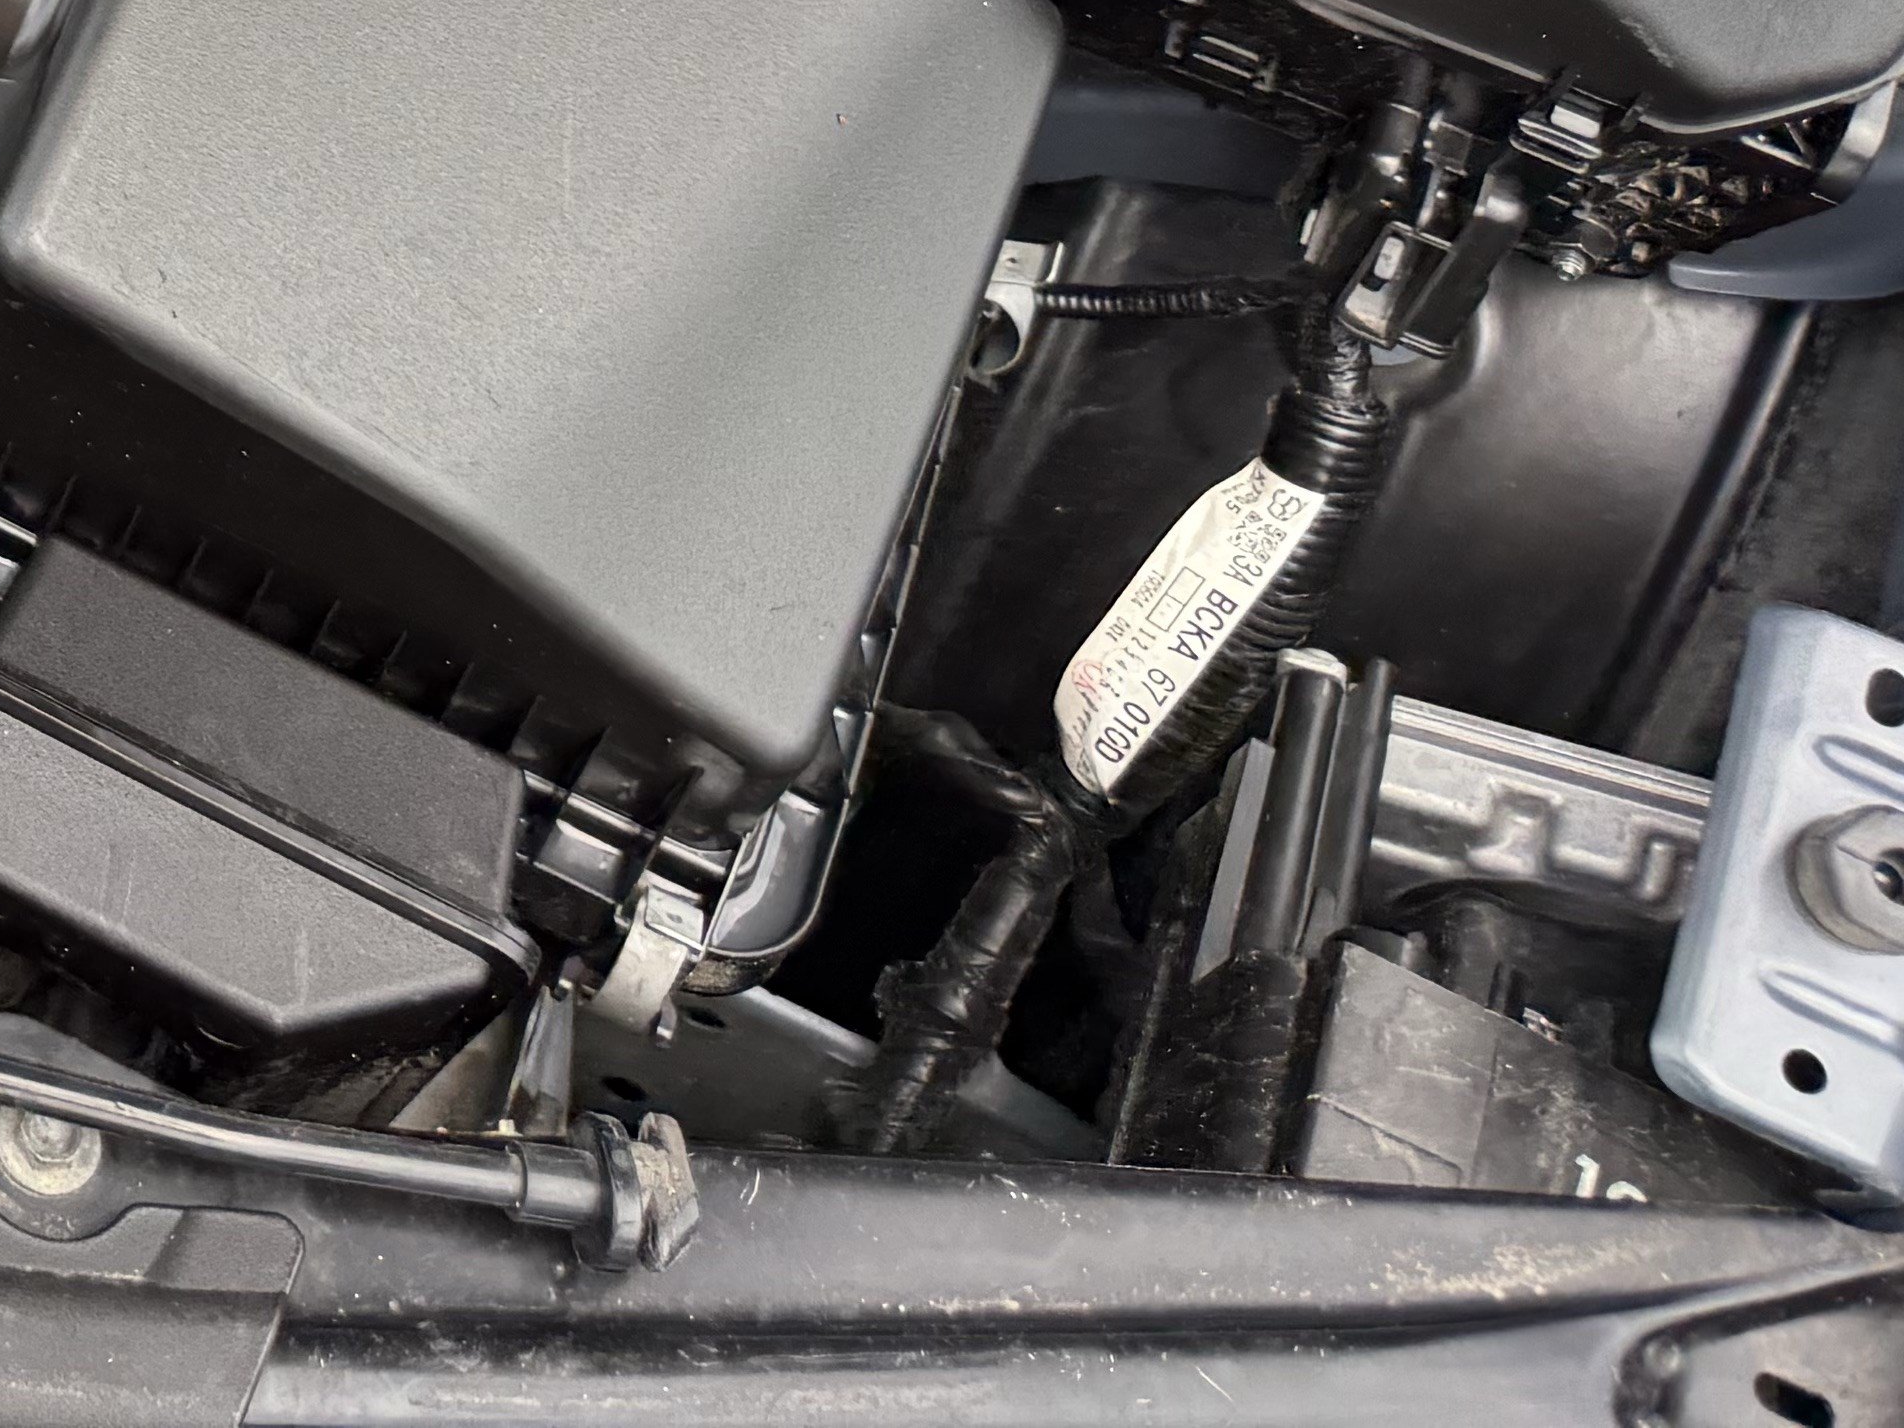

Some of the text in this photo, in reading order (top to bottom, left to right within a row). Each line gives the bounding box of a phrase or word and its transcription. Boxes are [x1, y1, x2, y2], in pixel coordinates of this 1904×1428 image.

[1222, 554, 1263, 587] 3A
[1167, 588, 1239, 661] BCKA
[1141, 668, 1176, 707] 67
